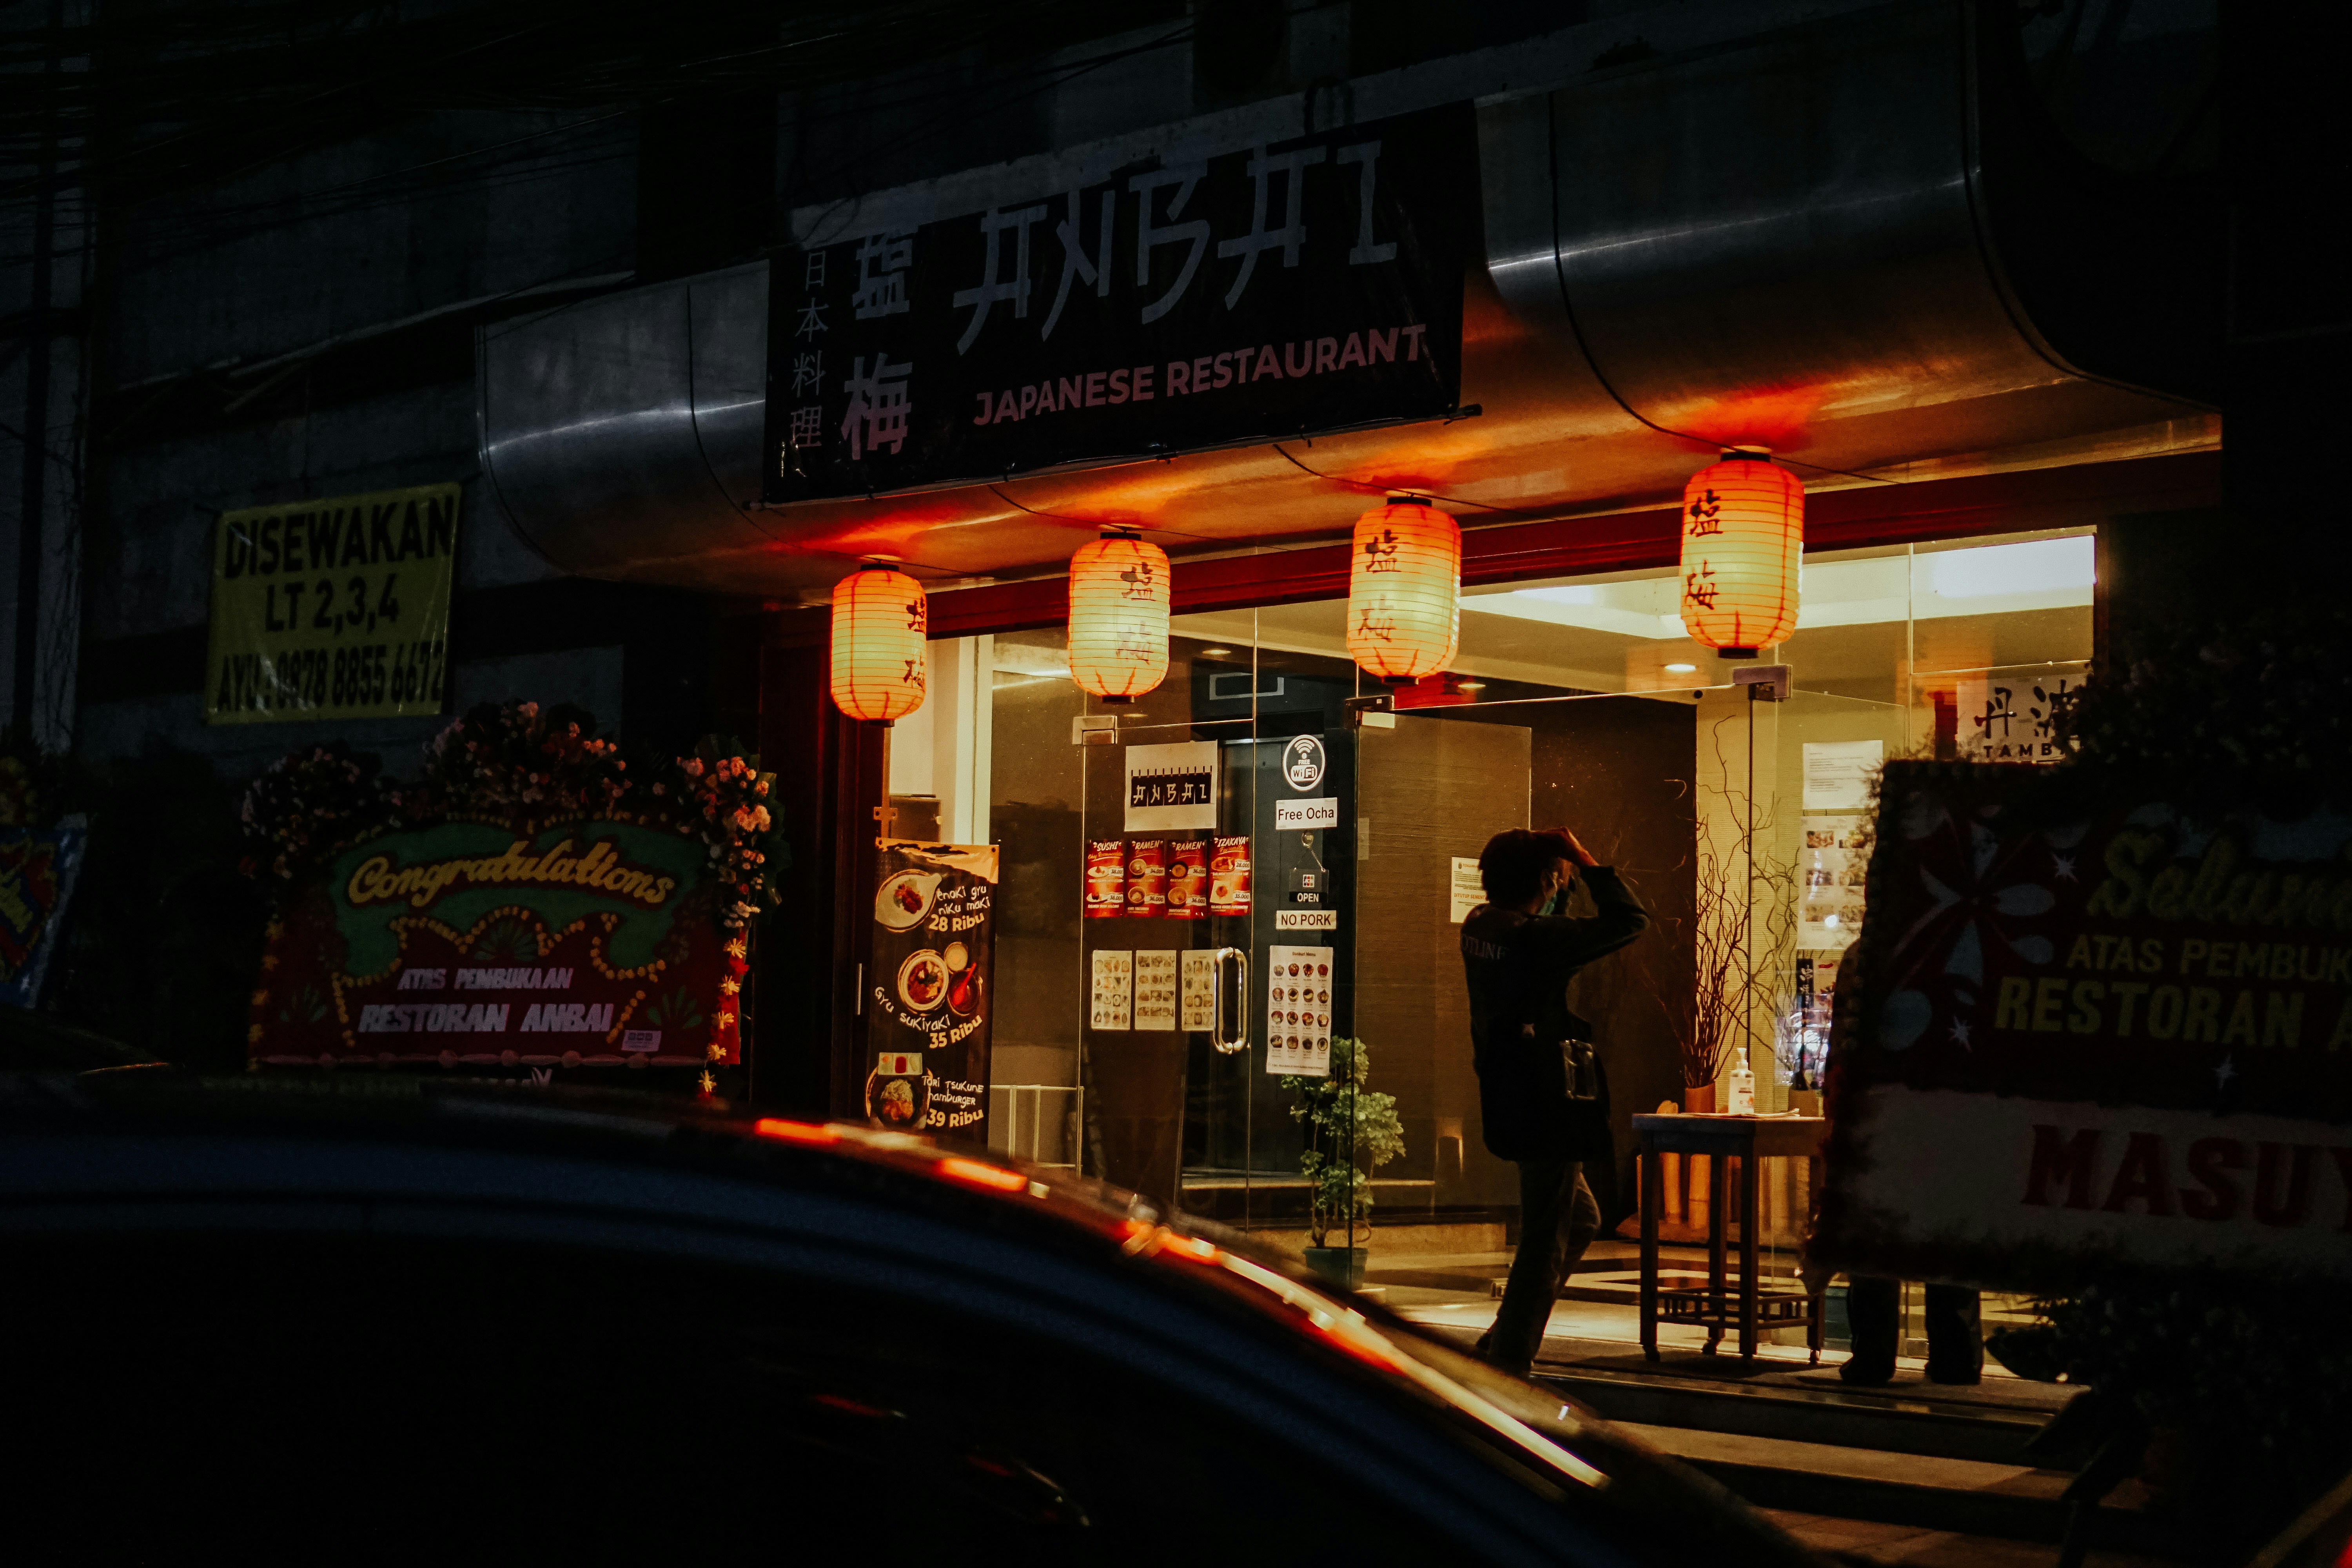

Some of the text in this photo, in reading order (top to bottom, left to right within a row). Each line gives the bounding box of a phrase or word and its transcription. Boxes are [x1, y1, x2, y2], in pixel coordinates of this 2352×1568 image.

[790, 250, 829, 448] 日本料理
[840, 234, 913, 461] 塩梅
[973, 324, 1427, 426] JAPANESE RESTAURANT
[224, 495, 454, 578] DISEWAKAN
[265, 573, 398, 635] LT 2,3,4
[332, 644, 387, 706] 8855
[391, 639, 445, 704] 6672
[1984, 743, 2065, 758] TAMB
[1278, 807, 1334, 820] Free Ocha
[1097, 841, 1119, 851] SUSHI
[1135, 840, 1160, 850] RAMEN
[1176, 841, 1202, 851] RAMEN
[1217, 836, 1246, 847] IZAKAYA
[347, 839, 676, 907] Congratulations
[1297, 893, 1319, 902] OPEN
[929, 912, 985, 932] 28 Ribu
[1281, 914, 1331, 926] NO PORK
[2067, 933, 2164, 973] ATAS
[357, 1003, 510, 1033] RESTORAN
[1994, 976, 2305, 1049] RESTORAN
[929, 1015, 983, 1049] 35 Ribu
[927, 1108, 984, 1128] 39 Ribu
